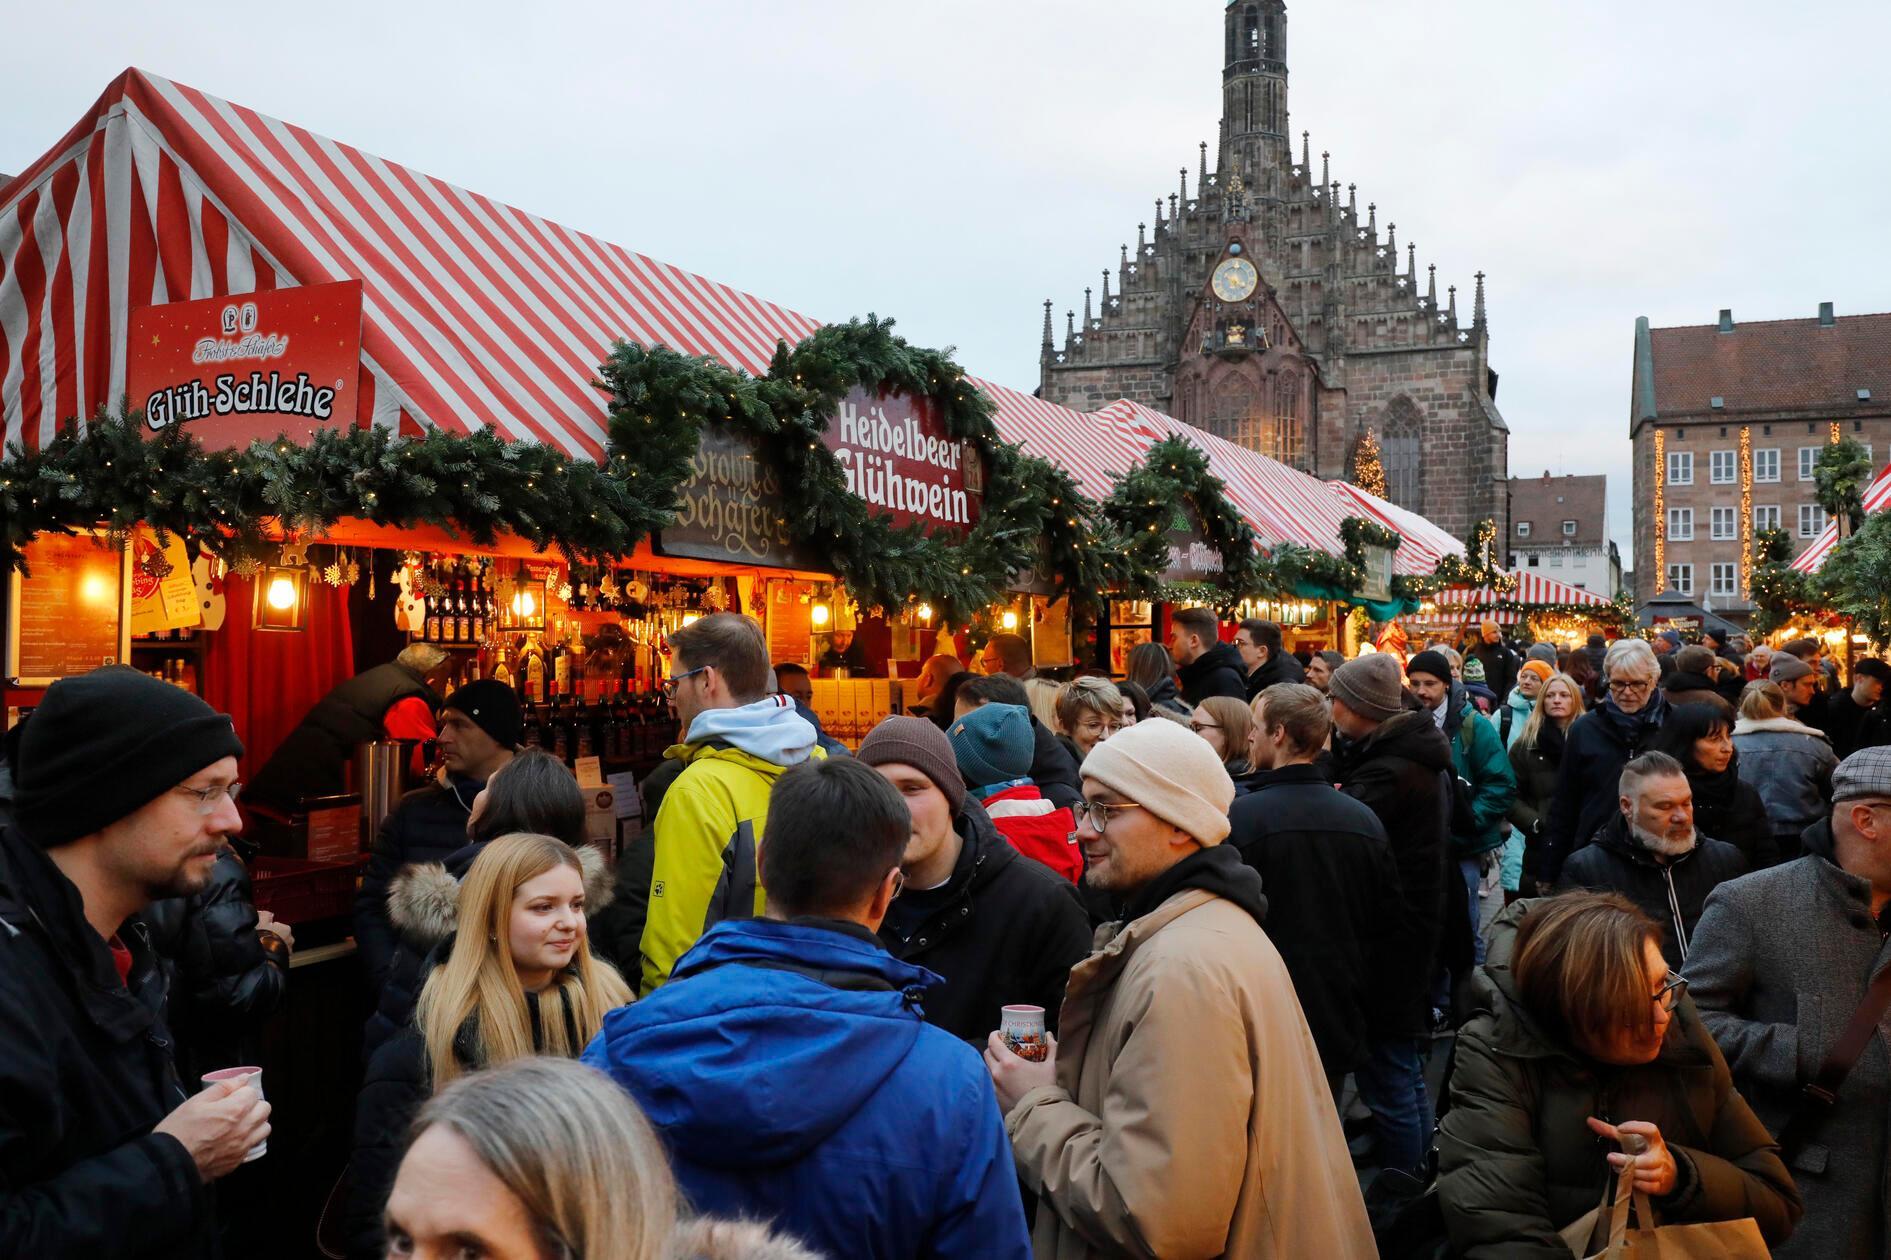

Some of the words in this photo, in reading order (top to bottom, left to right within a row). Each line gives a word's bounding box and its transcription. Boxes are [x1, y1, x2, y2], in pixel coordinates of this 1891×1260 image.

[146, 372, 335, 430] Glüh-Schlehe
[838, 401, 961, 471] Heidelbeer
[673, 484, 772, 558] Schäfer
[833, 447, 970, 524] Glühwein
